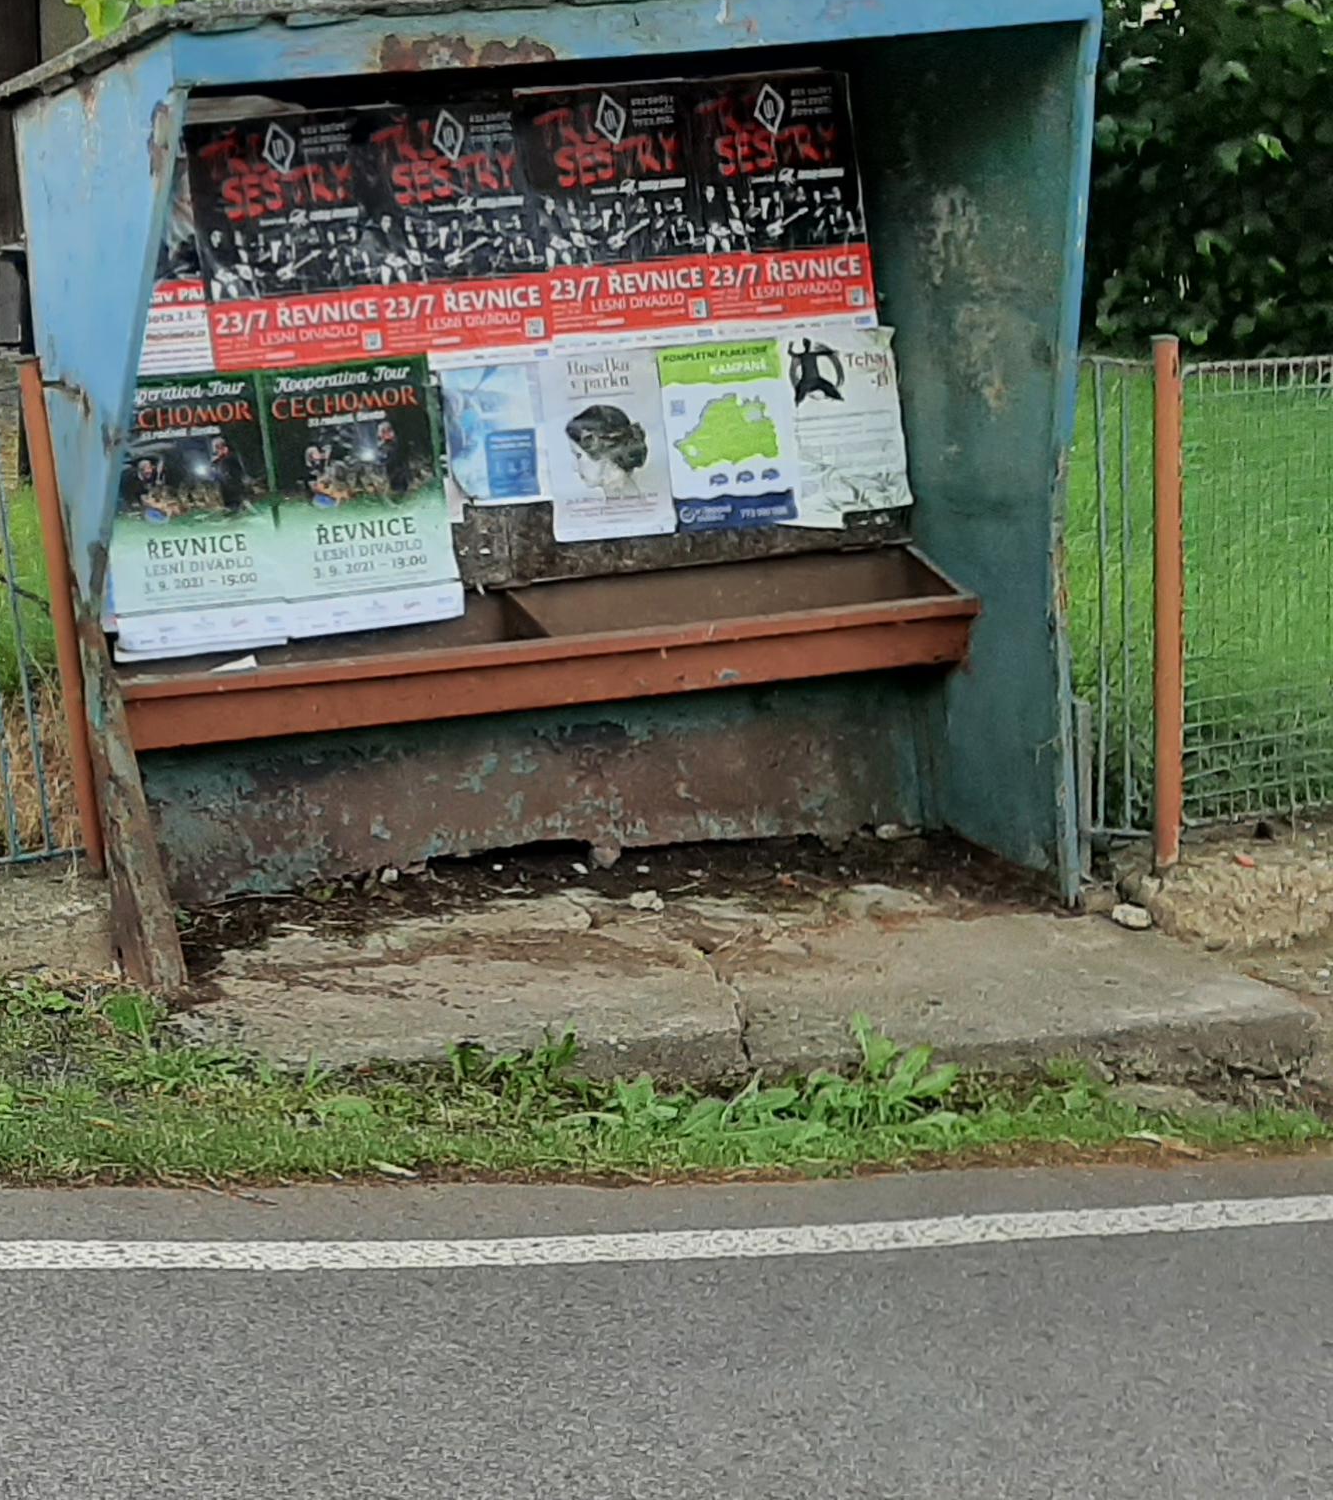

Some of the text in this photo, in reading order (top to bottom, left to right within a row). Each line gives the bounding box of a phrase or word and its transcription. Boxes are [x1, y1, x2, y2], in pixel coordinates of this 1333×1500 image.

[554, 132, 679, 190] SESTRY
[715, 122, 838, 178] SESTRY
[222, 158, 352, 222] SESTRY
[392, 148, 517, 206] SESTRY
[549, 267, 704, 302] 23/7 ŘEVNICE
[708, 255, 862, 288] 23/7 ŘEVNICE
[384, 285, 542, 320] 23/7 ŘEVNICE
[630, 291, 685, 309] DIVADLO
[787, 279, 843, 297] DIVADLO
[215, 309, 268, 336] 23/7
[276, 298, 380, 328] ŘEVNICE
[466, 311, 522, 328] DIVADLO
[299, 323, 358, 342] DIVADLO
[134, 381, 246, 405] perativa Tour
[273, 365, 411, 394] Kooperativa Tour
[137, 400, 253, 429] CHOMOR
[316, 516, 417, 546] ŘEVNICE
[146, 532, 248, 560] ŘEVNICE
[313, 538, 423, 562] LESNÍ DIVADLO
[144, 555, 254, 578] LESNÍ DIVADLO
[345, 561, 375, 575] 2021
[174, 577, 204, 590] 2021
